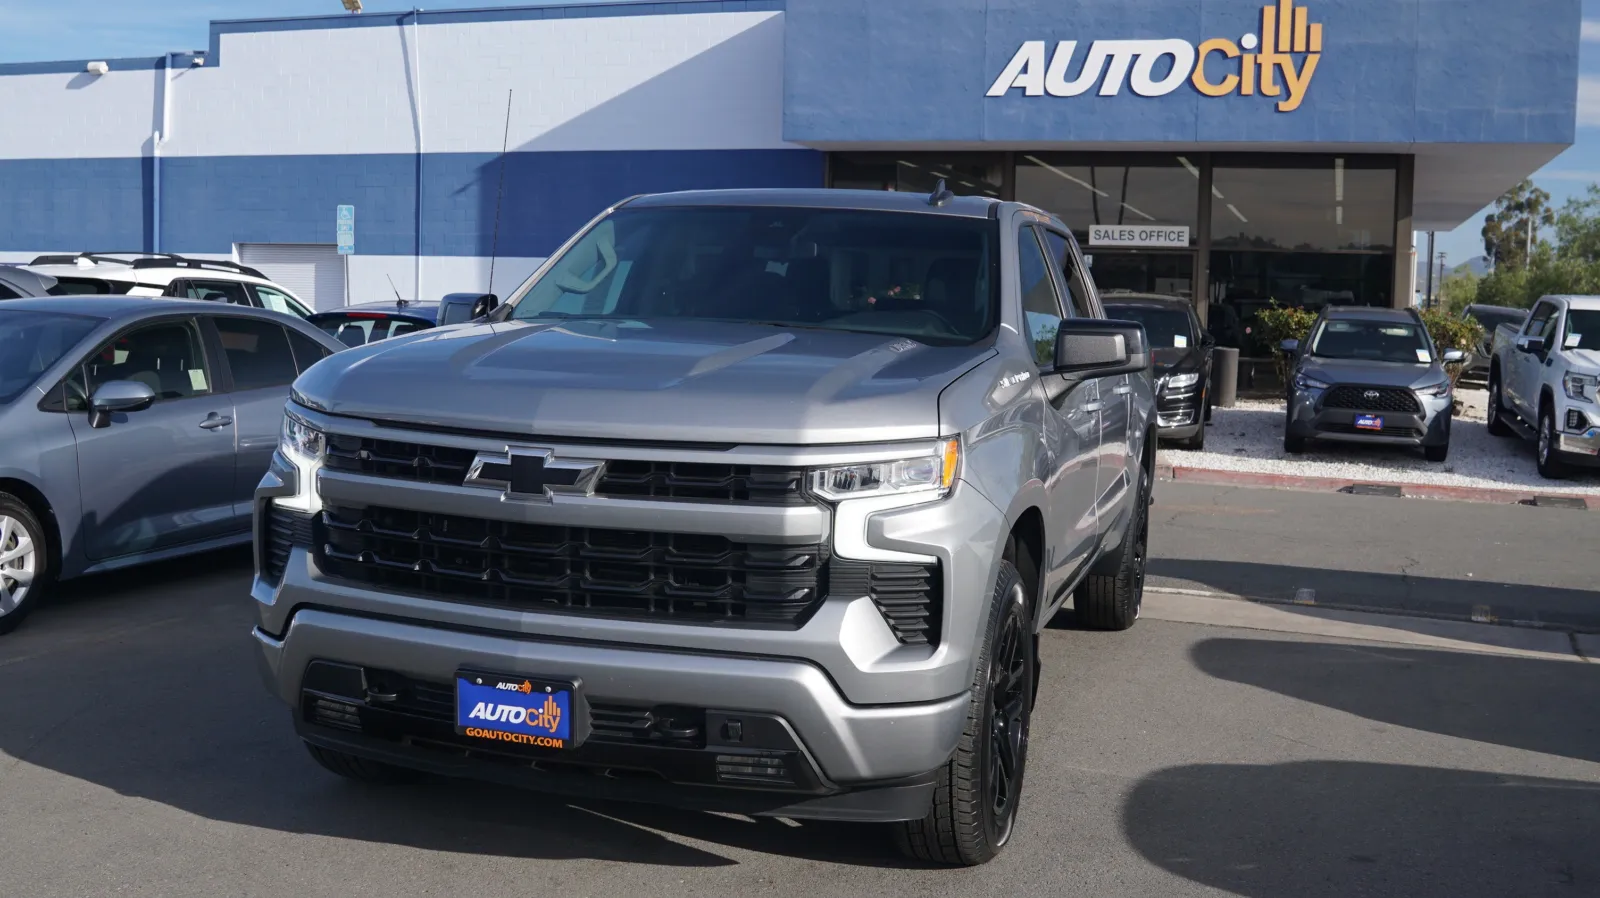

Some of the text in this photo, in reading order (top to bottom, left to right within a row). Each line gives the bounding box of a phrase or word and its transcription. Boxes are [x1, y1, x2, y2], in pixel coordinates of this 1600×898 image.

[1093, 229, 1185, 242] SALES OFFICE
[465, 727, 563, 749] GOAUTOCITY.COM
